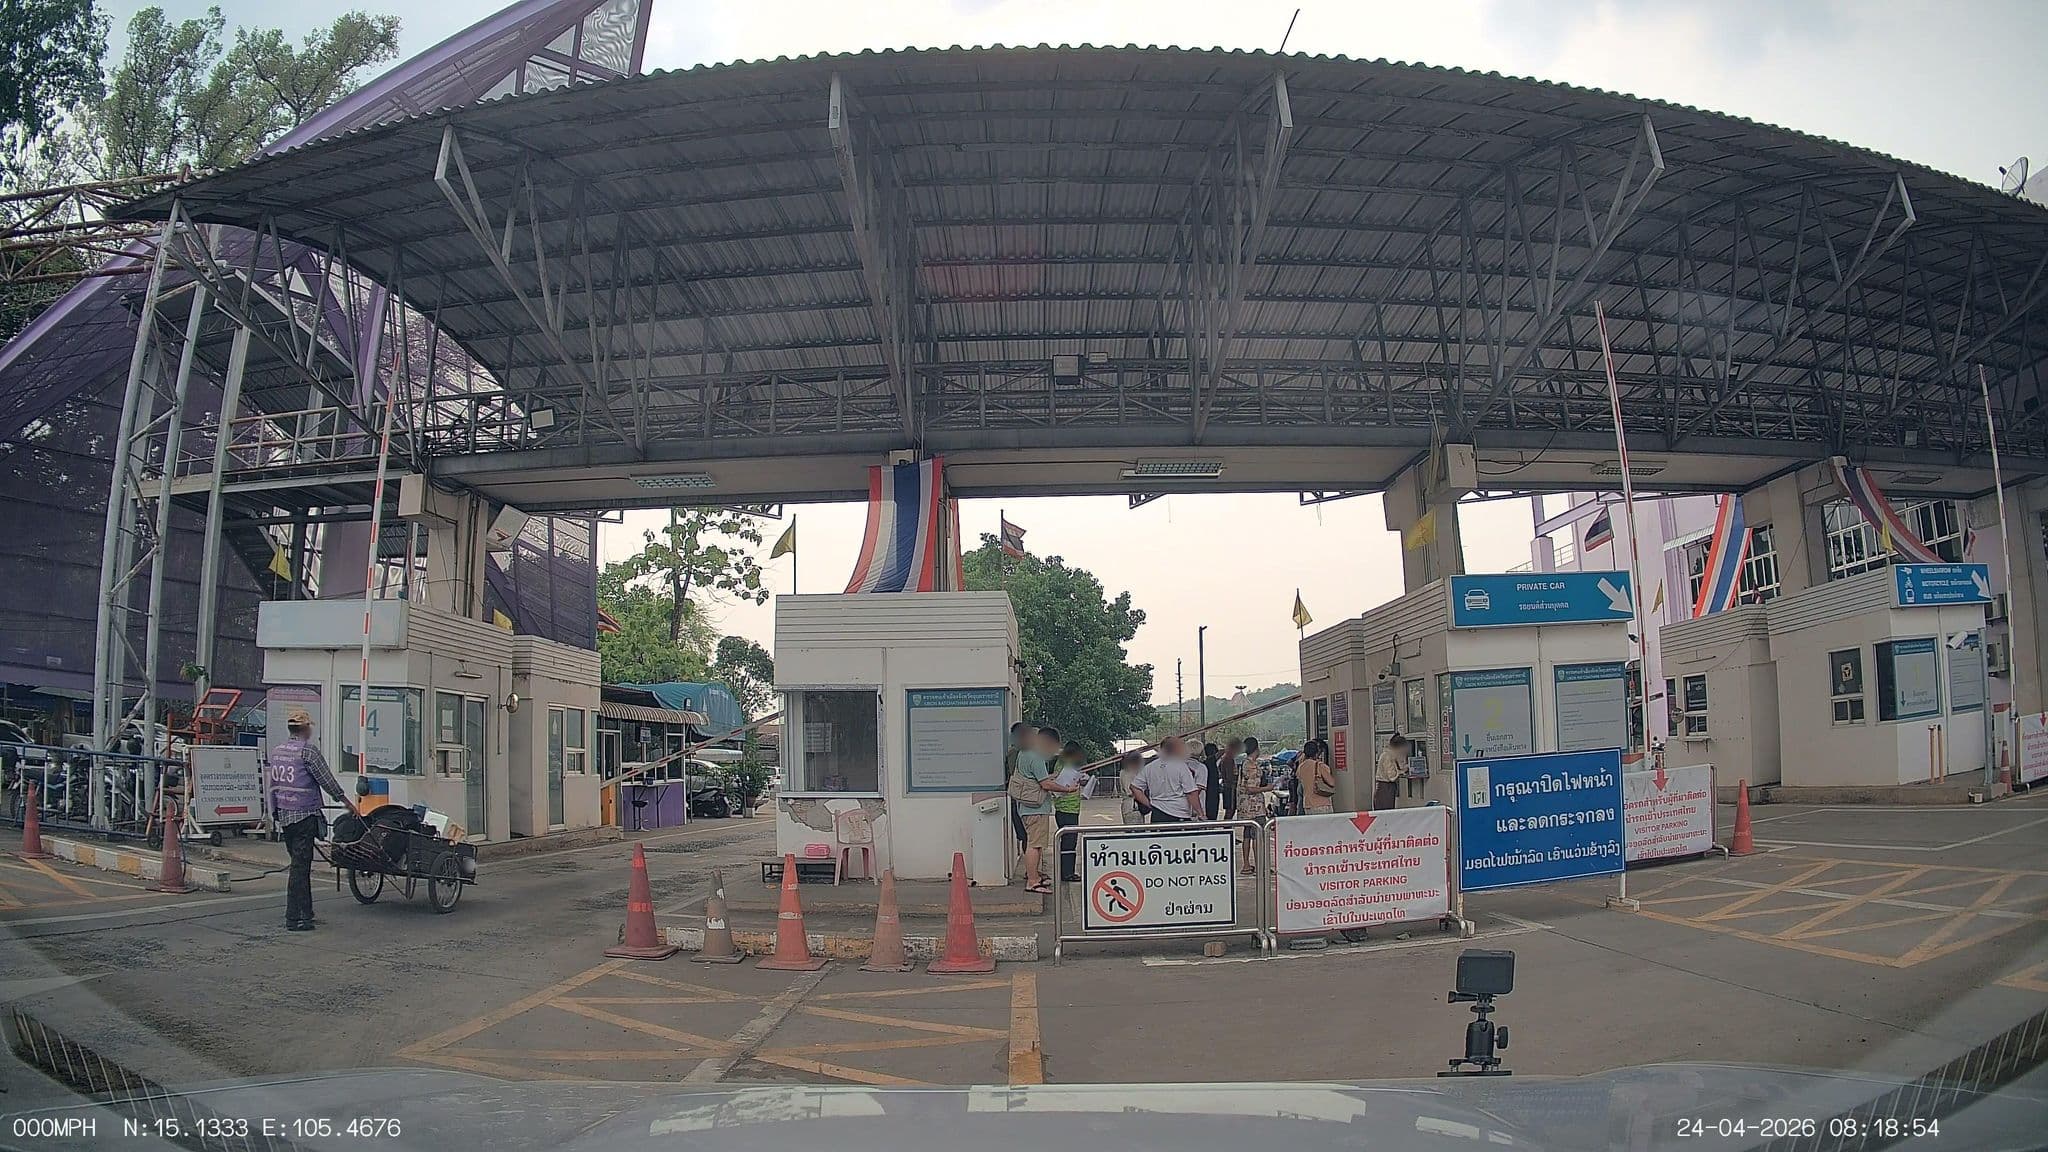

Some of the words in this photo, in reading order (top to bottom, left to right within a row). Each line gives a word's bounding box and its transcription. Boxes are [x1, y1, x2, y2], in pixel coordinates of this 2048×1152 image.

[1517, 582, 1547, 592] PRIVATE
[1550, 581, 1565, 590] CAR
[1519, 600, 1569, 612] รถยนต์ส่วนบุคคล
[366, 709, 380, 737] 4
[1483, 699, 1504, 729] 2
[271, 765, 295, 783] 023
[1495, 768, 1613, 802] กรุณาปิดไฟหน้า
[1496, 808, 1615, 833] และลดกระจกลง
[1635, 824, 1660, 834] VISITOR
[1661, 820, 1688, 831] PARKING
[1090, 843, 1228, 867] ห้ามเดินผ่าน
[1284, 834, 1439, 858] ที่จอดรถสำหรับผู้ที่มาติดต่อ
[1304, 855, 1421, 876] นำรถเข้าประเทศไทย
[1146, 877, 1164, 888] DO
[1168, 876, 1195, 887] NOT
[1199, 874, 1227, 886] PASS
[1319, 879, 1360, 891] VISITOR
[1363, 875, 1408, 888] PARKING
[1165, 901, 1213, 915] ຢ່າຜ່ານ
